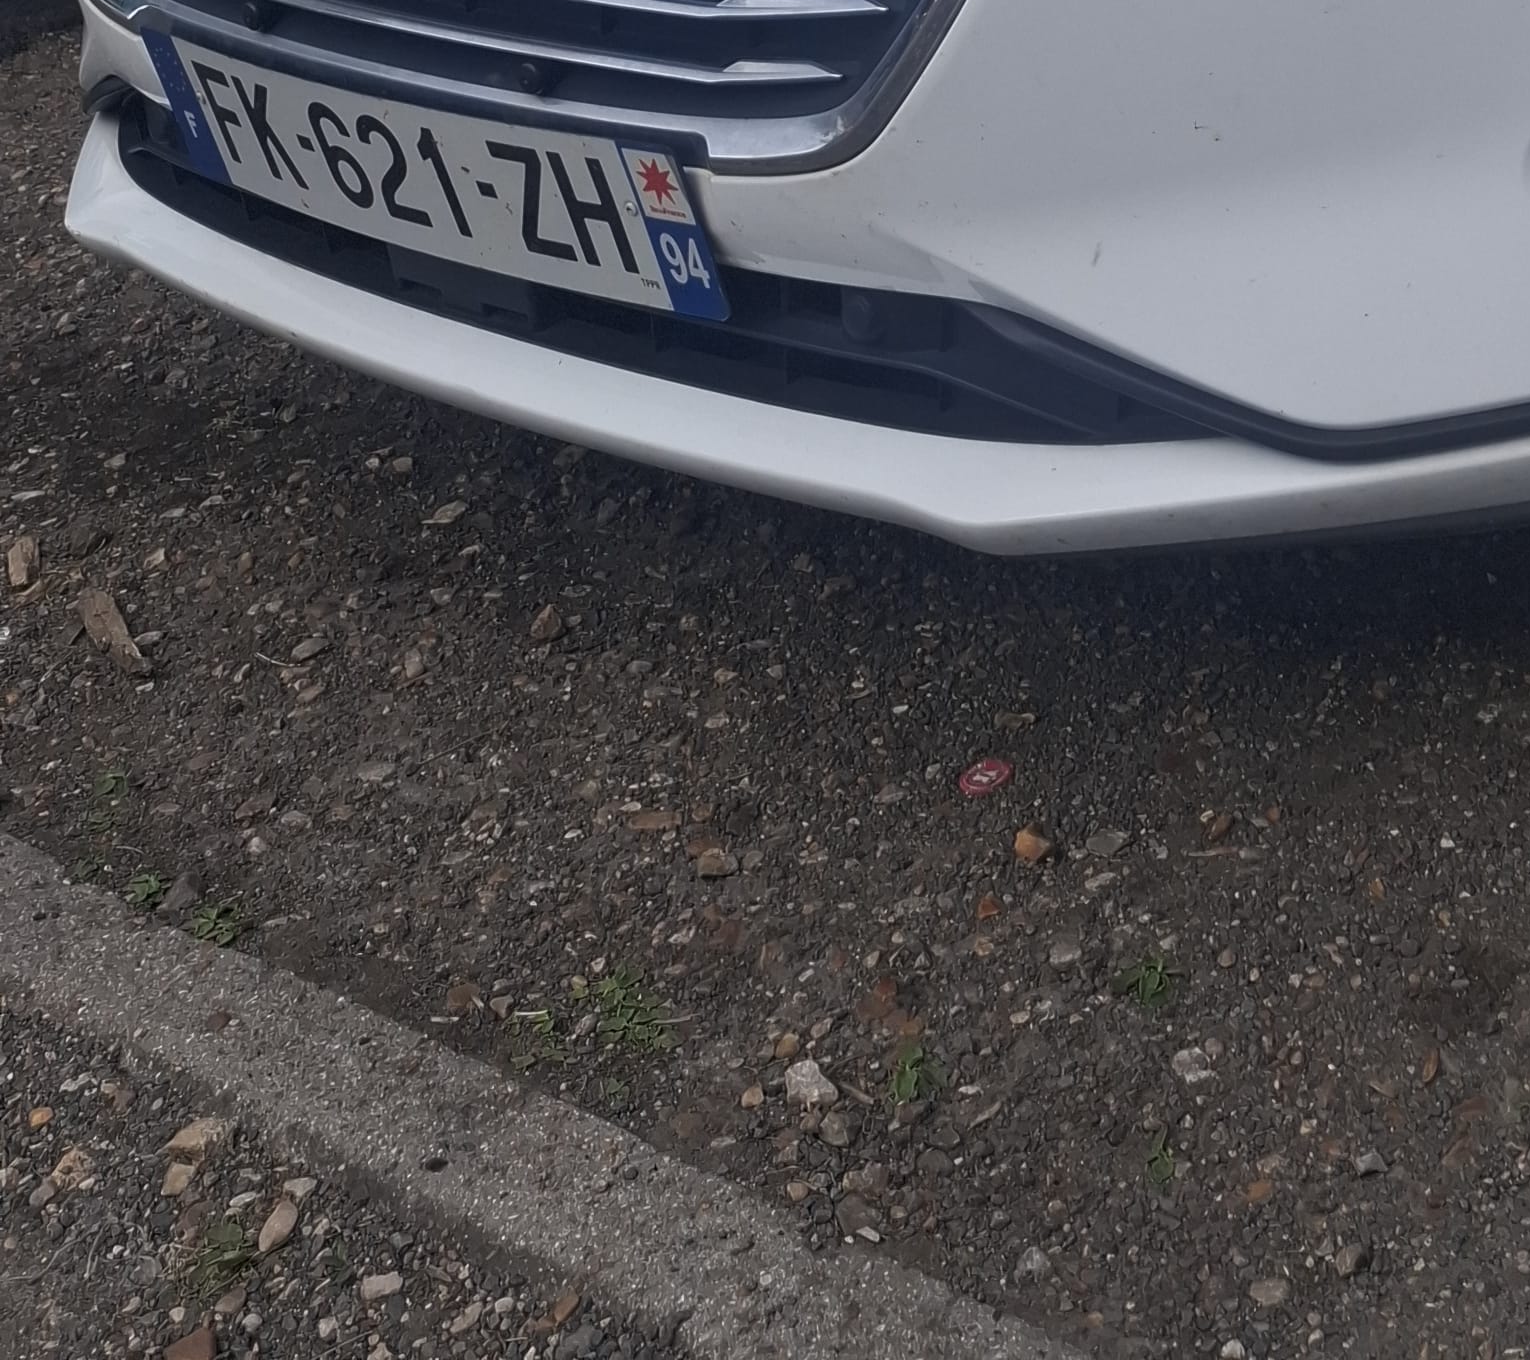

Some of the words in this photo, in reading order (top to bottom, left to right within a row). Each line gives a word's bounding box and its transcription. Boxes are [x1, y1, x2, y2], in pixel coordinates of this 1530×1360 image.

[184, 110, 198, 138] F
[190, 60, 641, 275] FK-621-ZH
[659, 232, 710, 289] 94
